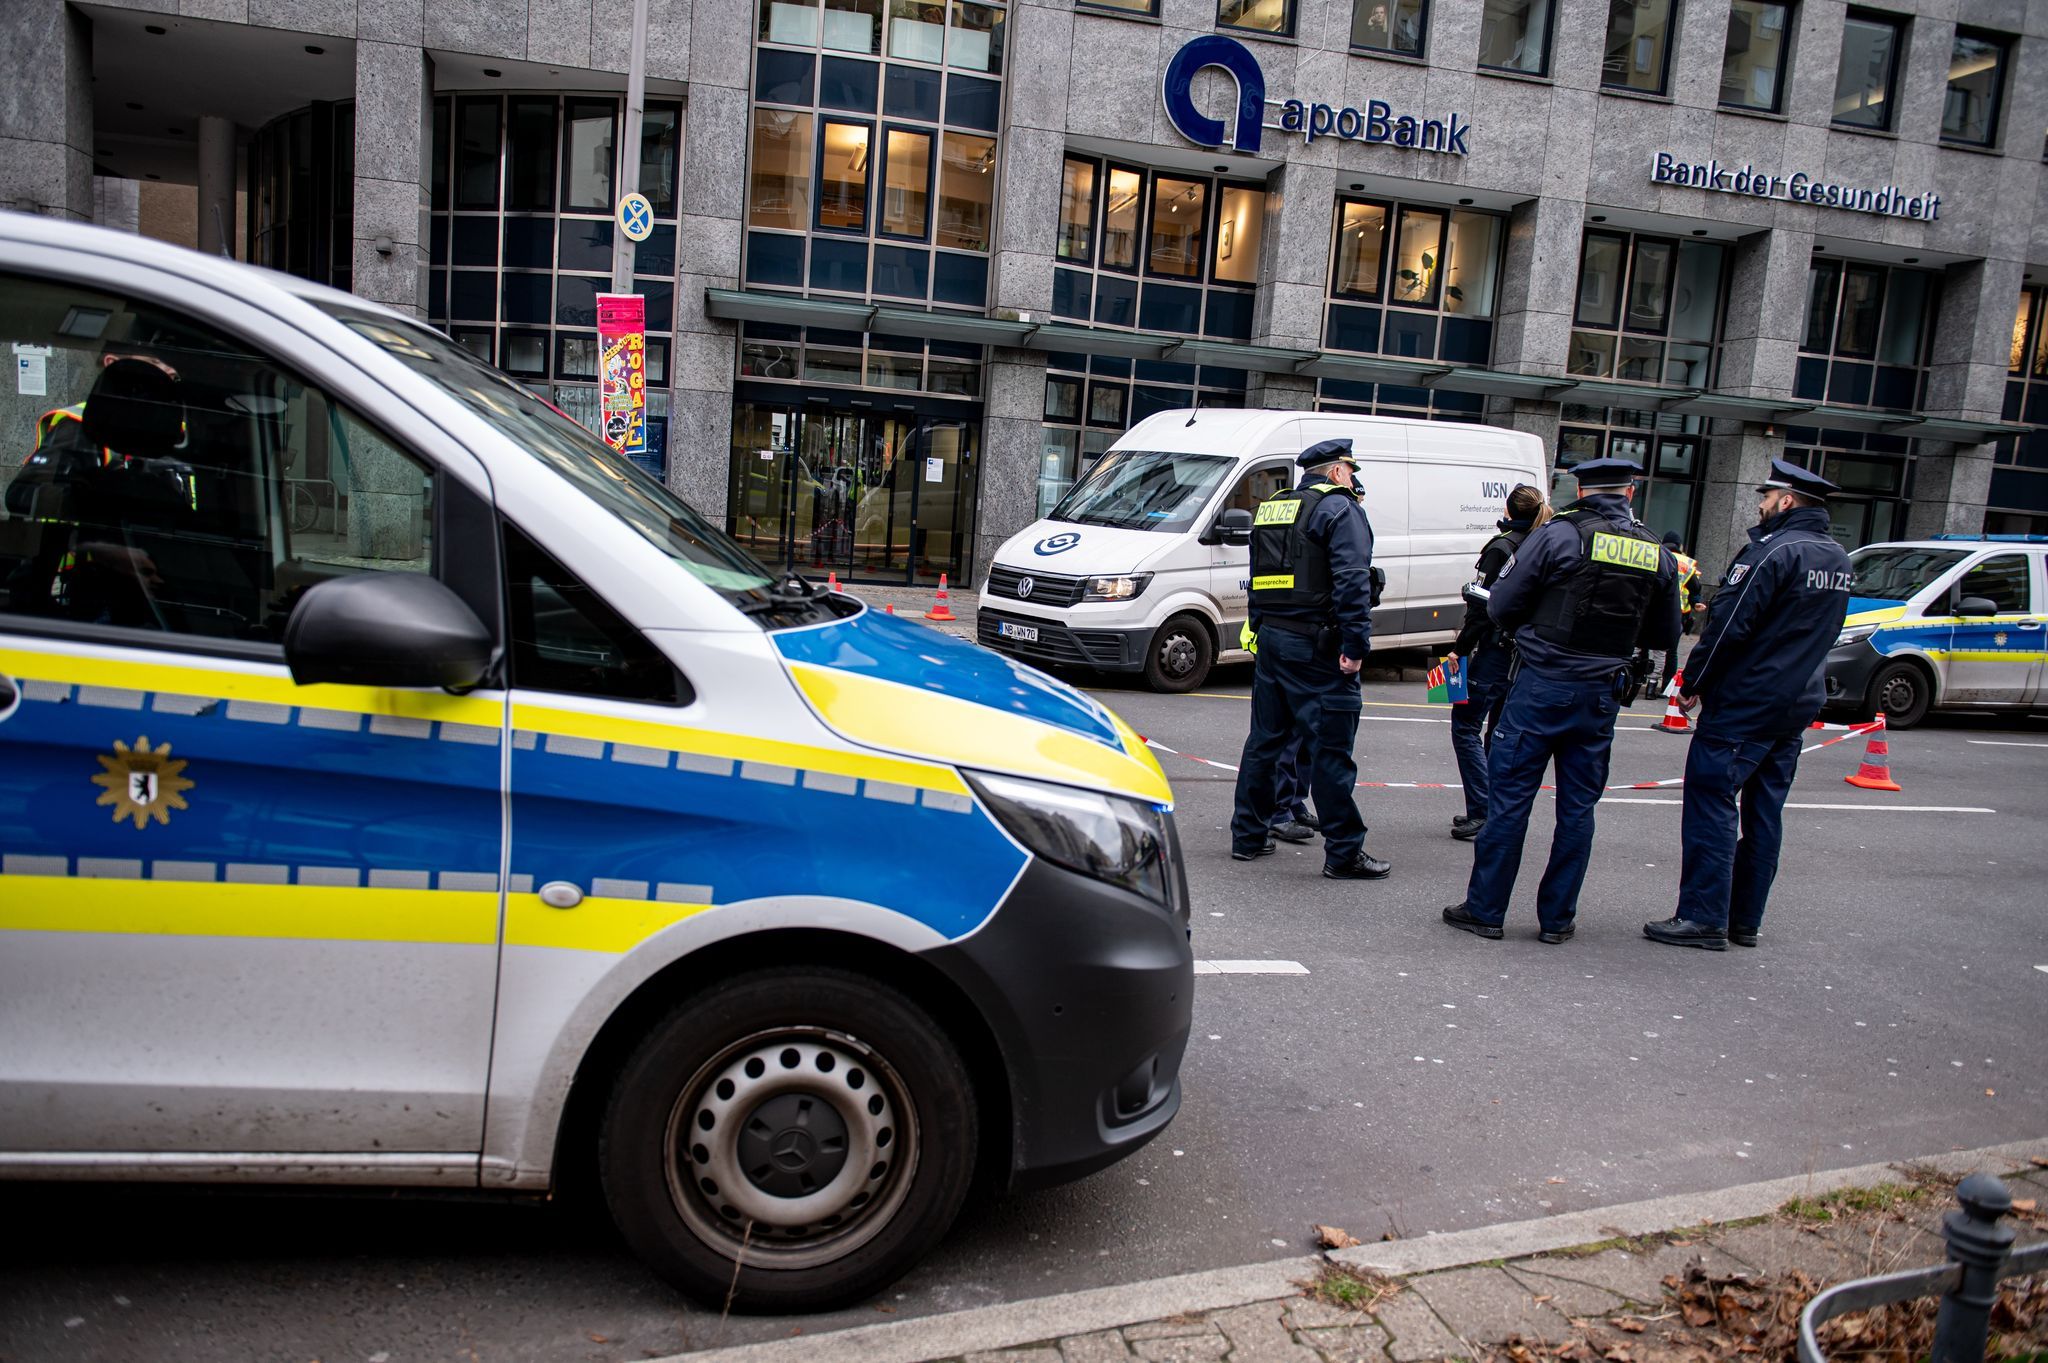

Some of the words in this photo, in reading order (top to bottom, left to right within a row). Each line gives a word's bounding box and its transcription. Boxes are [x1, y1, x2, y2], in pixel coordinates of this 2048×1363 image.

[1279, 99, 1470, 155] apoBank
[1652, 152, 1725, 190] Bank
[1731, 165, 1780, 198] der
[1786, 172, 1941, 221] Gesundheit
[1482, 482, 1507, 498] WSN
[1256, 503, 1297, 522] POLIZEI
[1594, 535, 1658, 569] POLIZEI
[1806, 569, 1851, 592] POLIZE
